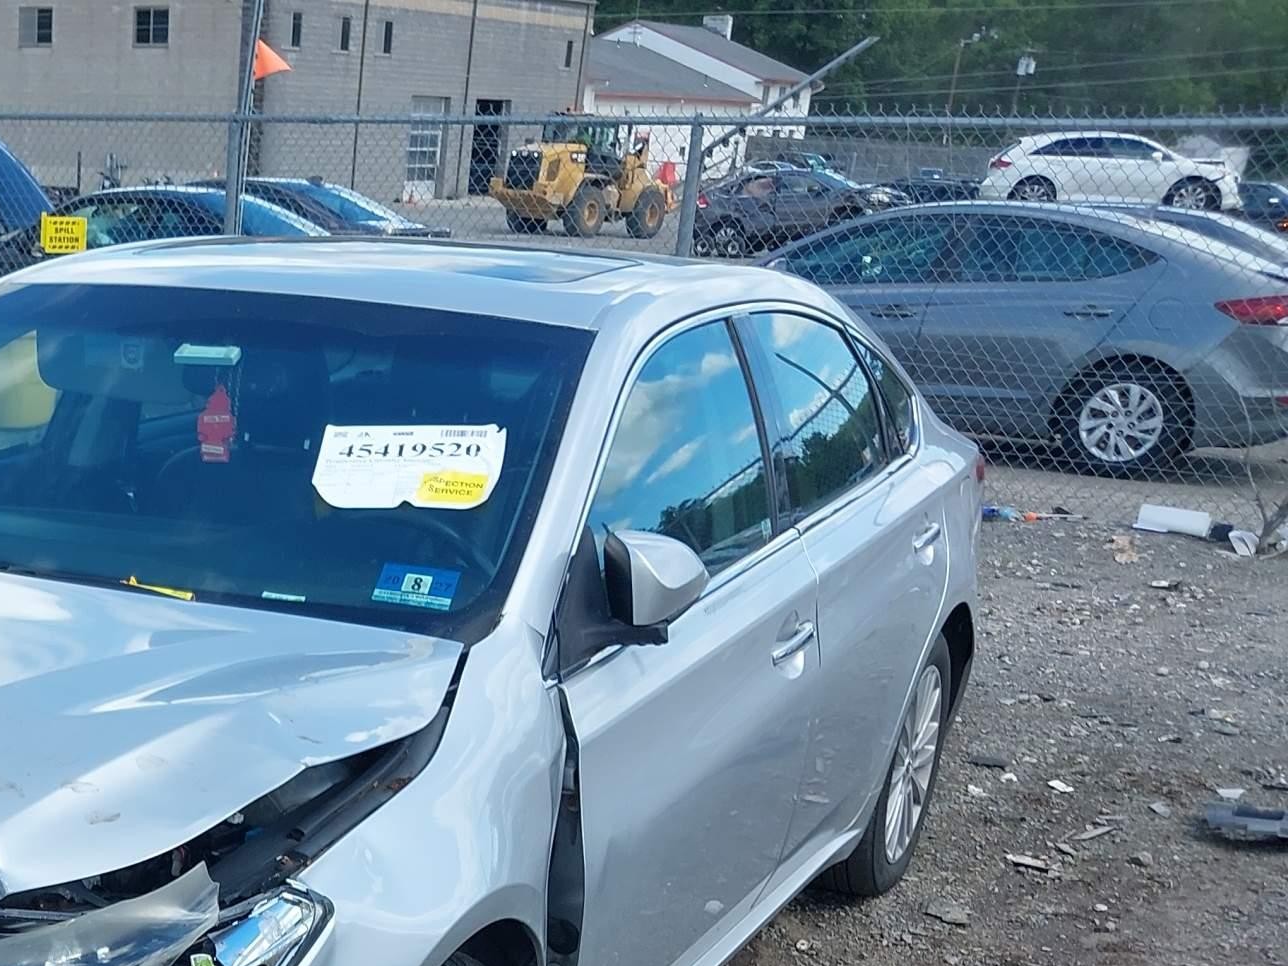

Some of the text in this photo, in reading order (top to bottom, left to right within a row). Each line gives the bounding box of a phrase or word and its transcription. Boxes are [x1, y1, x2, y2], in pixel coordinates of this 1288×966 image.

[54, 227, 75, 235] SPILL
[49, 236, 80, 244] STATION
[338, 442, 481, 458] 45419520
[428, 484, 473, 496] SERVICE
[411, 577, 424, 592] 8
